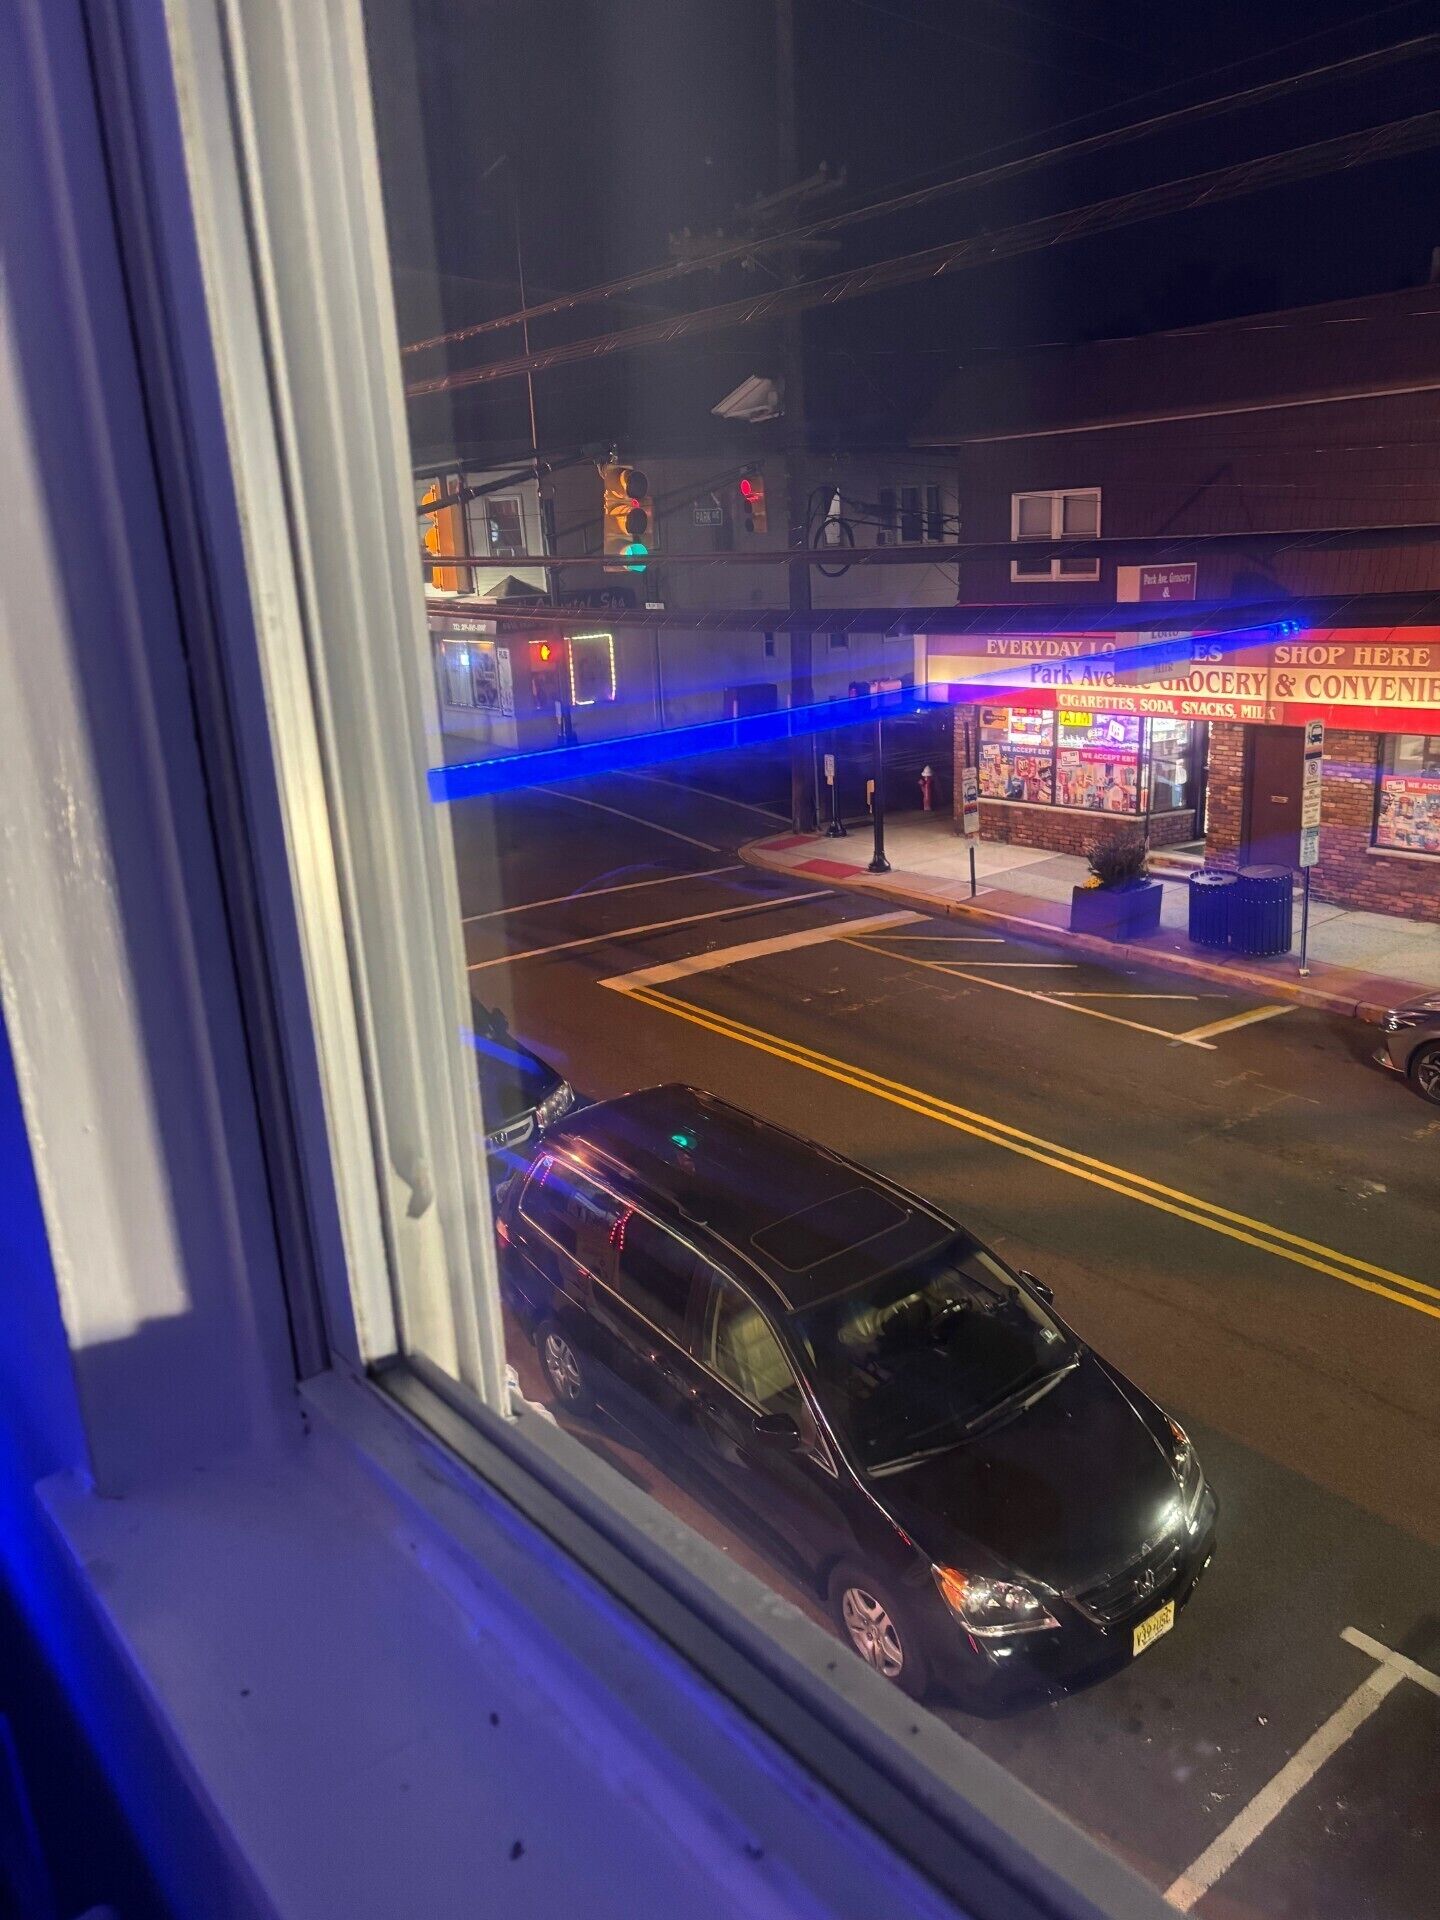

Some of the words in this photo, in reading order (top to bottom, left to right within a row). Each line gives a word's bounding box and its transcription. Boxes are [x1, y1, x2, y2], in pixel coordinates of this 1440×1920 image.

[987, 639, 1083, 657] EVERYDAY
[1274, 646, 1346, 665] SHOP
[1353, 647, 1431, 667] HERE
[1030, 663, 1073, 685] Park
[1275, 673, 1297, 698] &
[1058, 693, 1136, 713] CIGARETTES,
[1139, 698, 1178, 715] SODA,
[1182, 701, 1238, 720] SNACKS,
[1241, 705, 1276, 720] MILK
[1063, 712, 1091, 725] ATM
[1013, 746, 1036, 754] ACCEPT
[1094, 753, 1121, 761] ACCEPT
